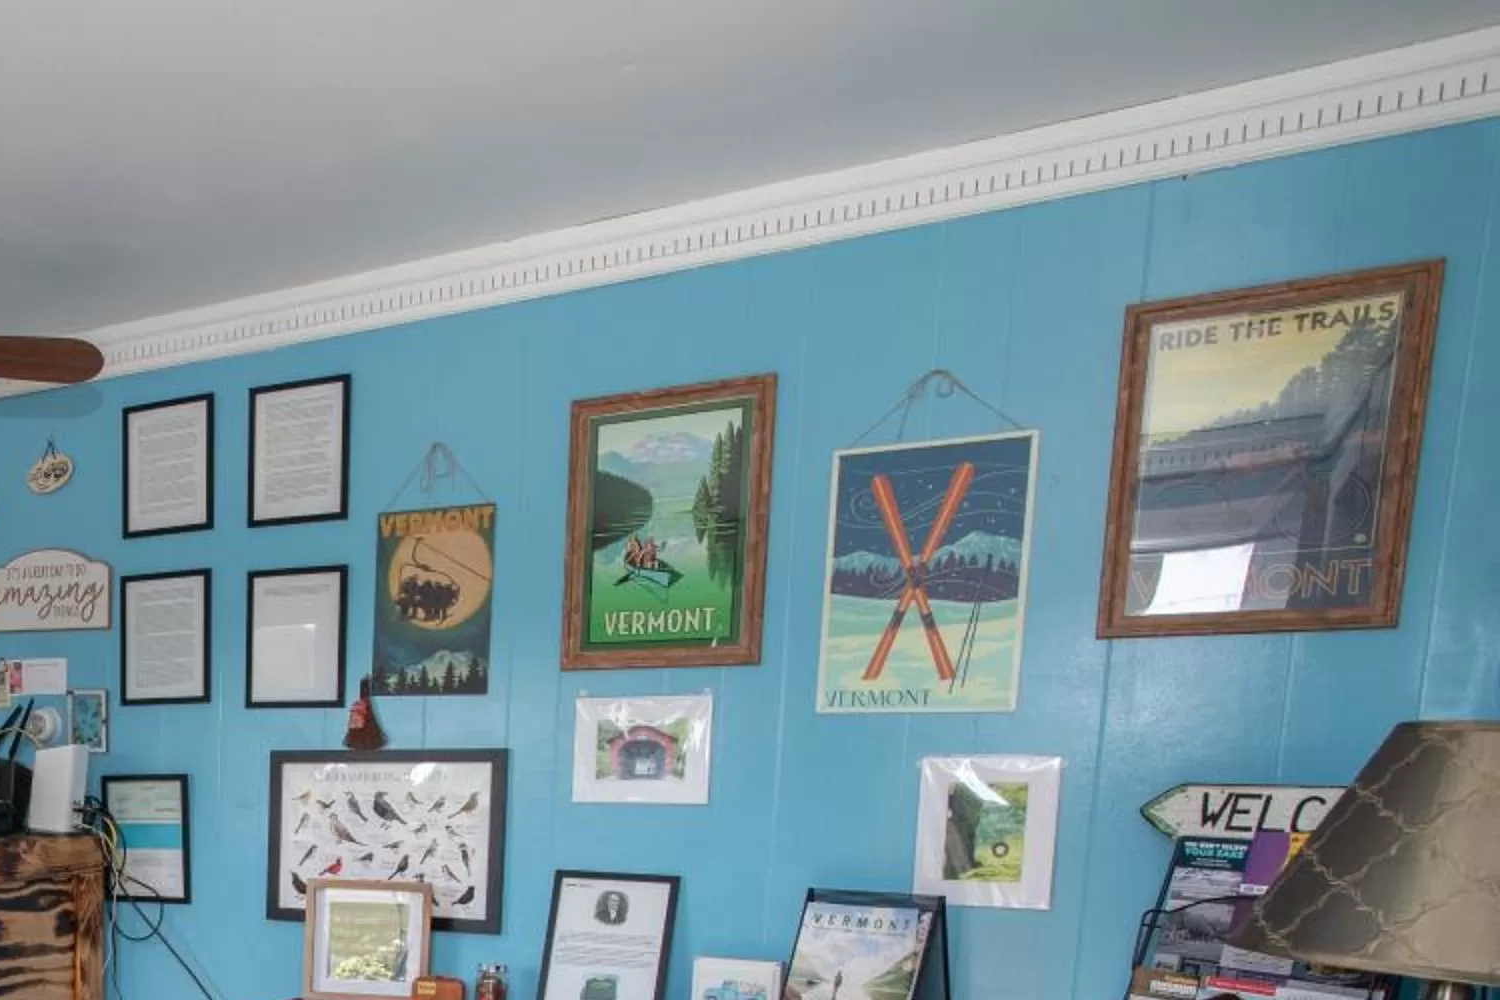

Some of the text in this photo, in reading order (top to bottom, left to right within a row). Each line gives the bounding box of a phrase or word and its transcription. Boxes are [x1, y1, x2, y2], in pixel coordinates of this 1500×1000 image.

[1158, 300, 1396, 351] RIDE THE TRAILS
[379, 505, 494, 538] VERMONT
[1132, 559, 1373, 601] VONT
[604, 606, 717, 636] VERMONT
[825, 687, 933, 709] VERMONT
[1199, 791, 1328, 833] WELC
[812, 912, 912, 930] VERMONT
